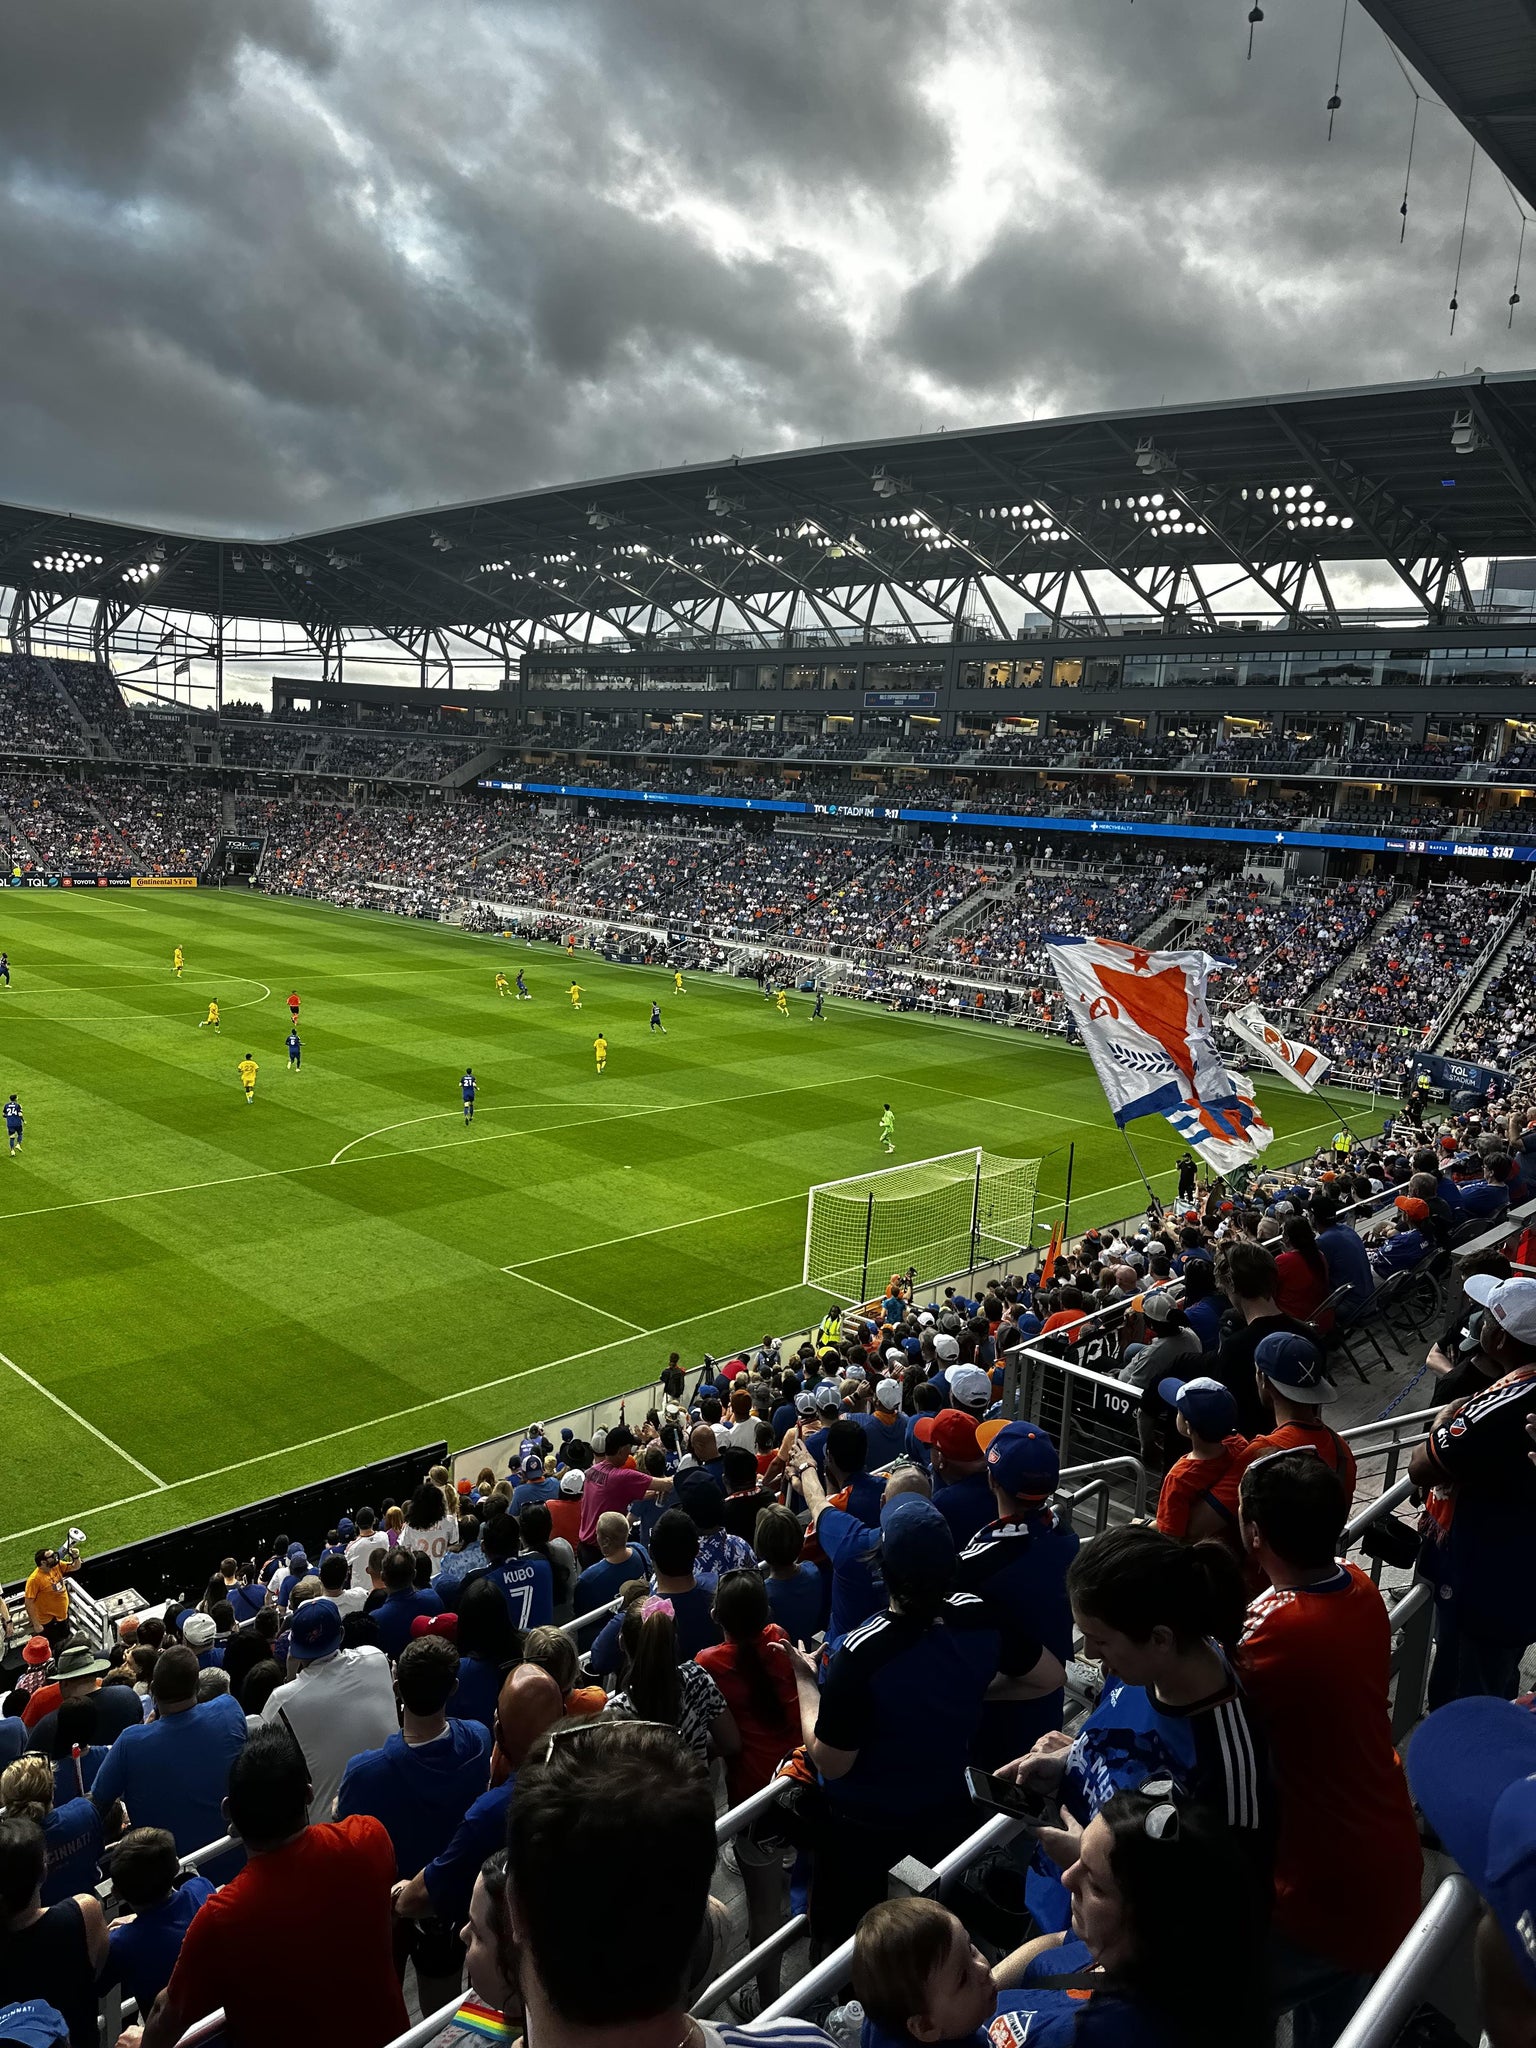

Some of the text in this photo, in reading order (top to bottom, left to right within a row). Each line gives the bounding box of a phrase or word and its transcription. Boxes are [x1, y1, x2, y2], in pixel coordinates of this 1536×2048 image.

[1453, 844, 1489, 858] Jackpot:
[1492, 846, 1515, 859] $747
[26, 878, 48, 887] TQL
[137, 878, 172, 886] Continental
[1450, 1064, 1469, 1078] TQL
[463, 1079, 472, 1087] 21
[1448, 1074, 1476, 1087] STADIUM
[6, 1107, 18, 1116] 24
[1103, 1393, 1130, 1415] 109
[503, 1566, 535, 1584] KUBO
[509, 1585, 534, 1630] 7
